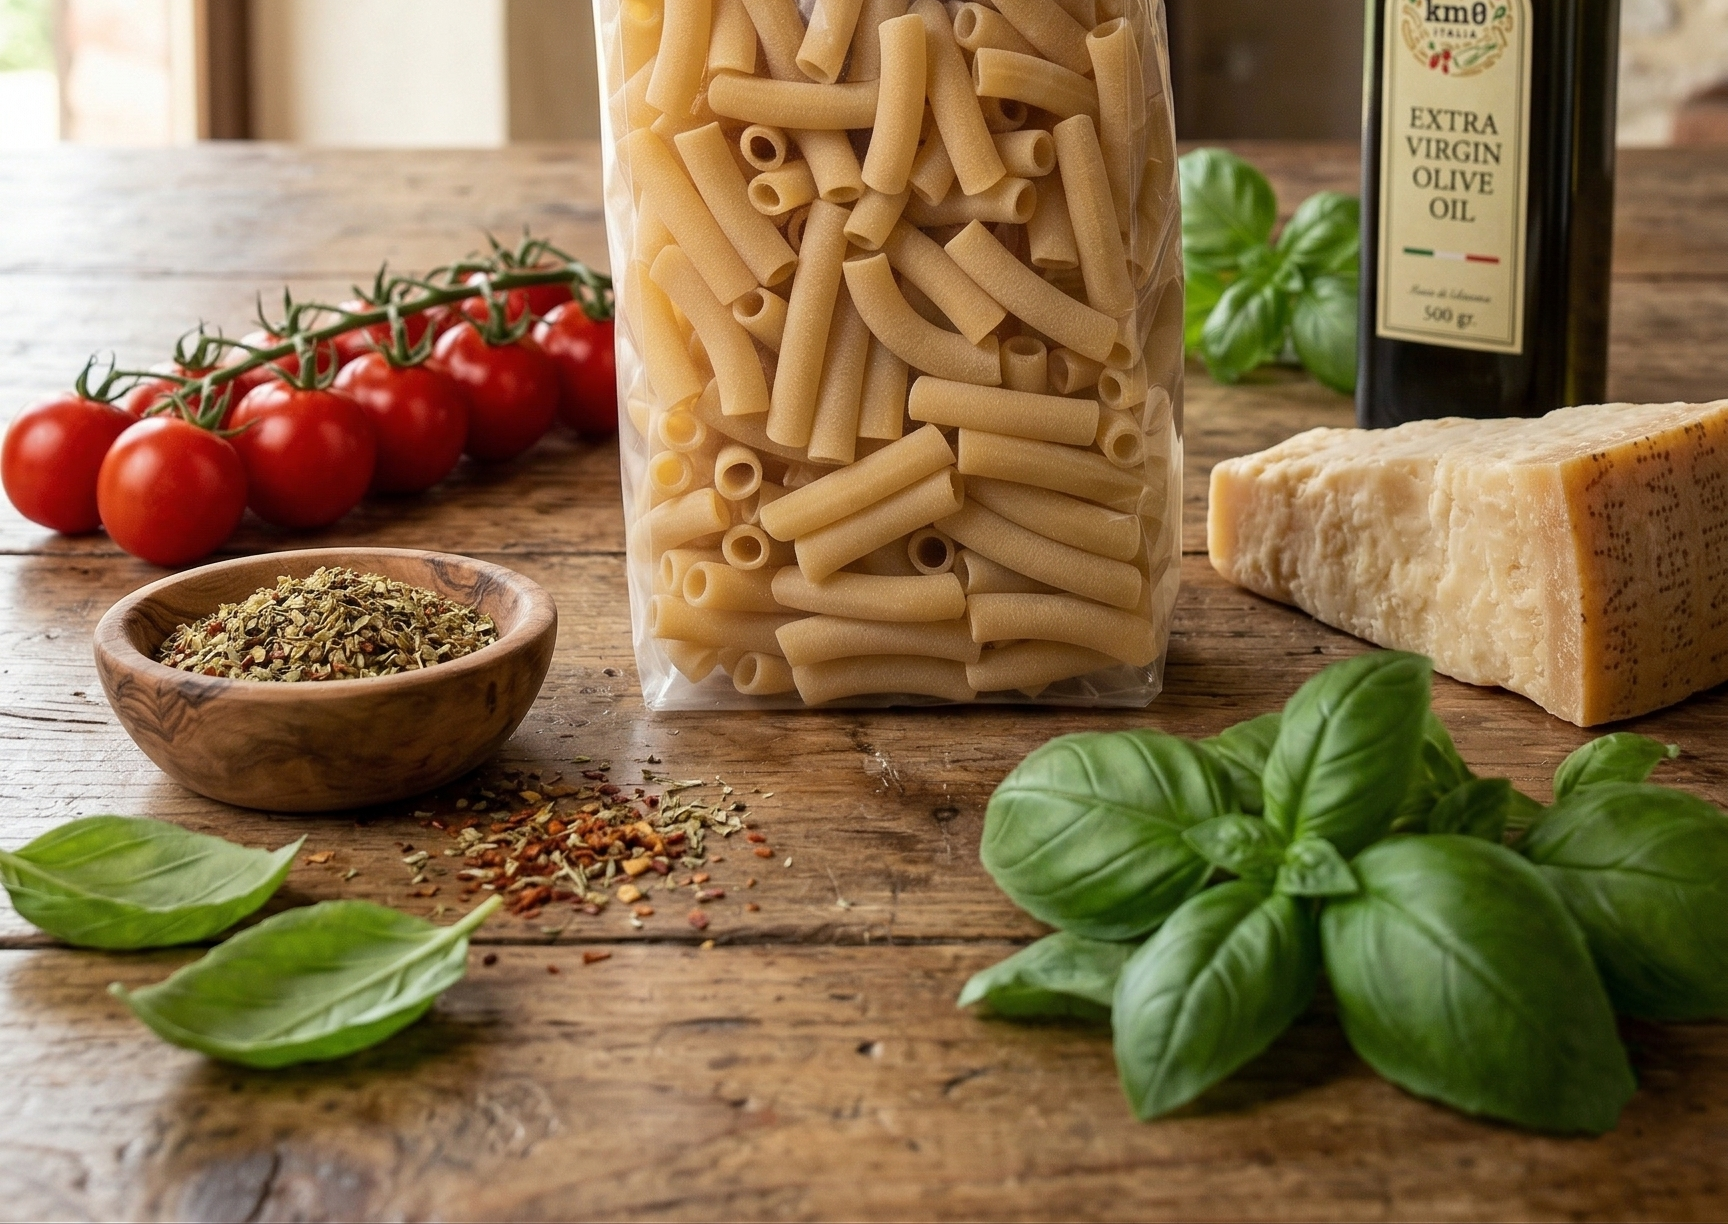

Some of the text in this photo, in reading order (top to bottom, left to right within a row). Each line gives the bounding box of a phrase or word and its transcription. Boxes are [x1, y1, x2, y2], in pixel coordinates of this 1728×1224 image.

[1410, 107, 1499, 135] EXTRA
[1406, 135, 1502, 165] VIRGIN
[1412, 167, 1494, 195] OLIVE
[1429, 197, 1476, 223] OIL
[1422, 305, 1454, 323] 500
